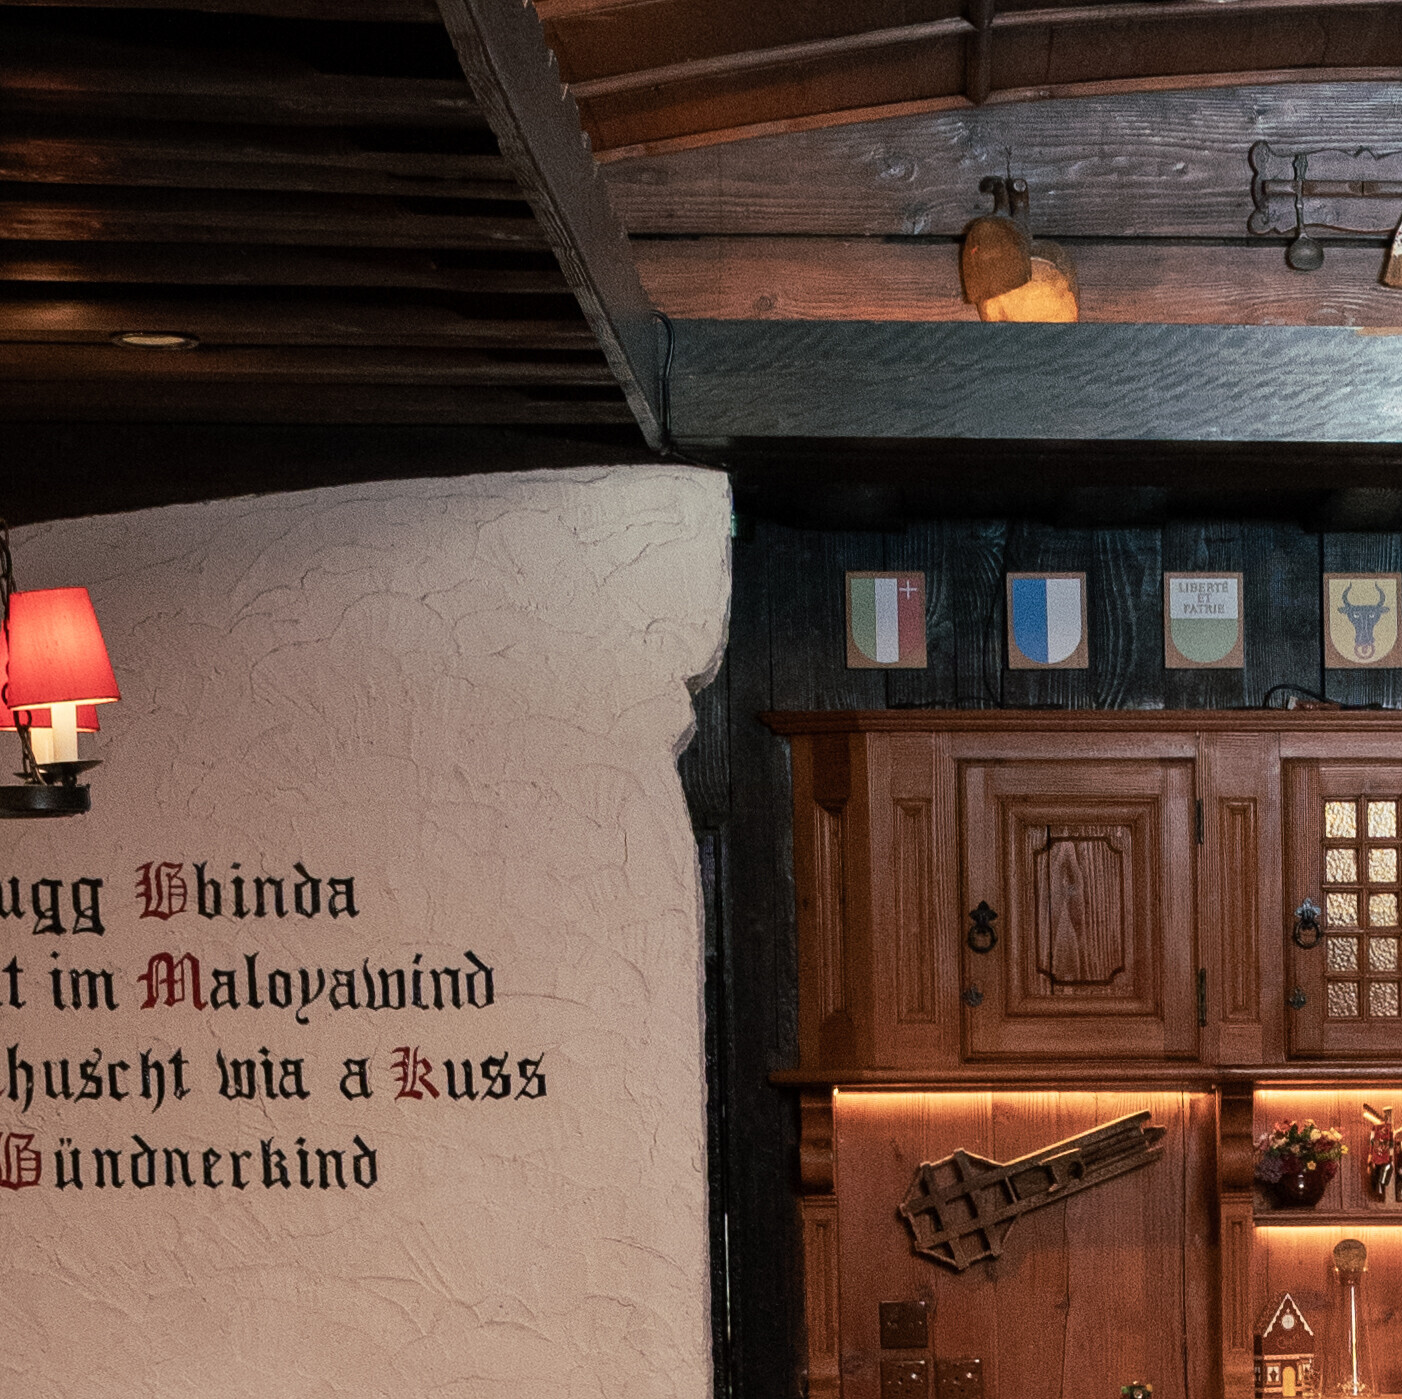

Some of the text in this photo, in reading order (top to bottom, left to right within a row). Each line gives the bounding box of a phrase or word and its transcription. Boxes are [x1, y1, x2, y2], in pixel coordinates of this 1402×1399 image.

[1183, 604, 1225, 615] PATRIE
[48, 950, 120, 1011] im
[0, 1043, 549, 1113] huscht wia a Kuss
